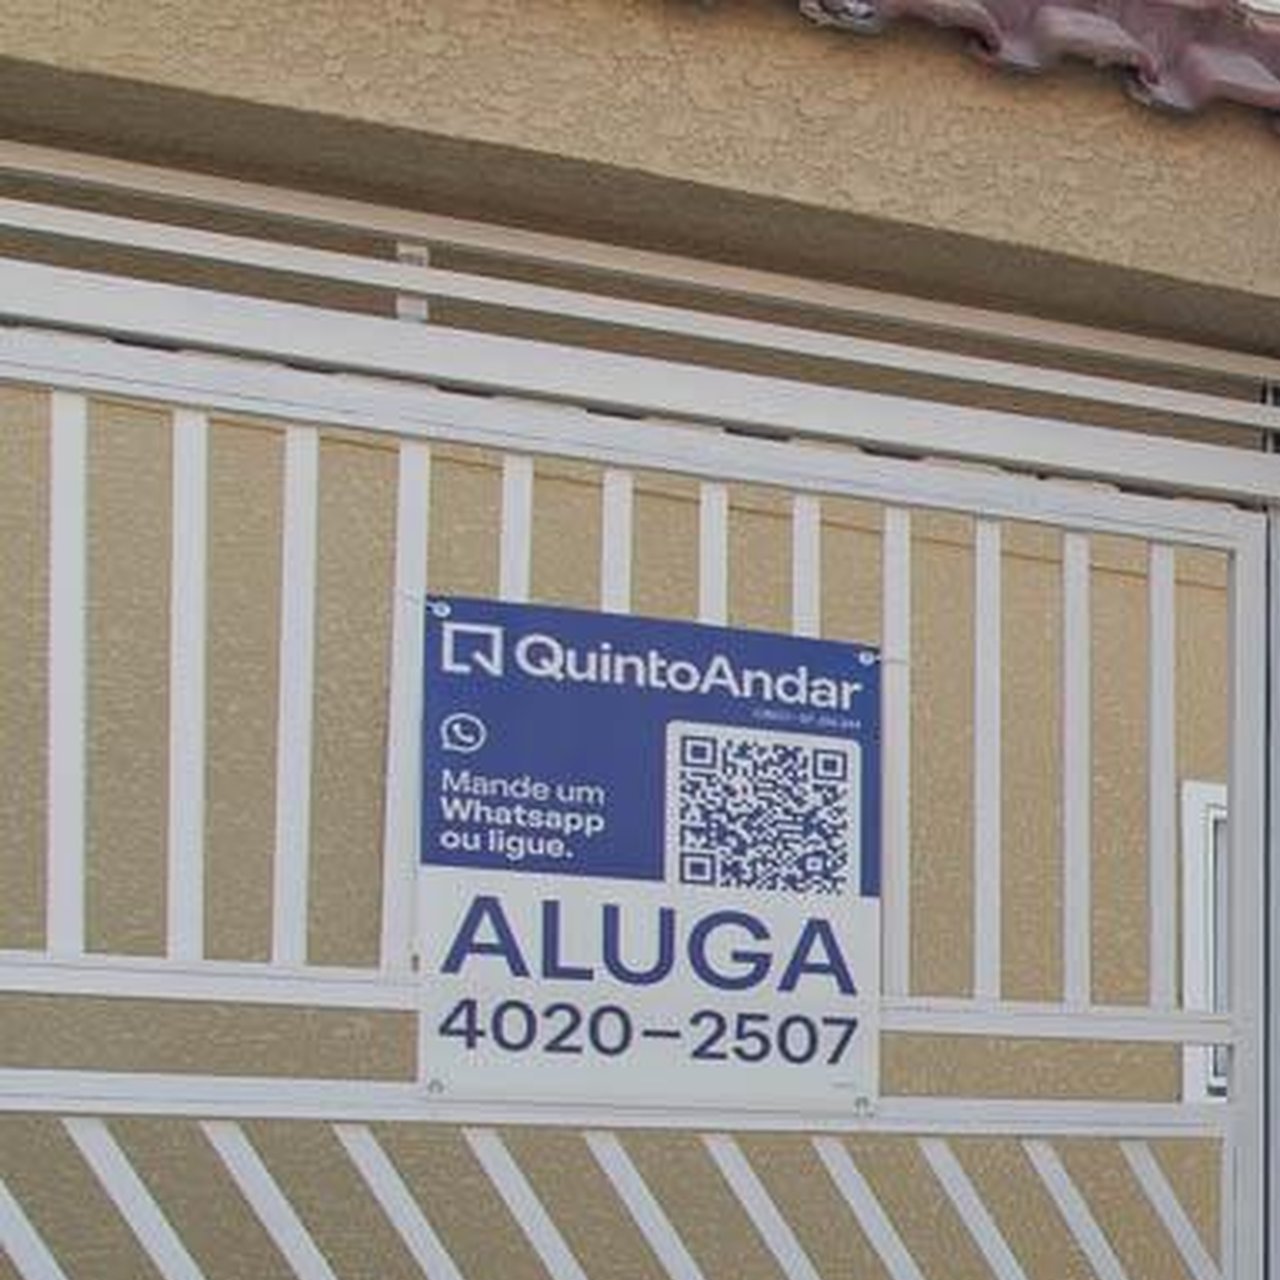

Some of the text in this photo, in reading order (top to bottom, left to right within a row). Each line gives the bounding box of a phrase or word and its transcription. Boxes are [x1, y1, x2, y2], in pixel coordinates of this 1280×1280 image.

[516, 634, 863, 710] QuintoAndar
[442, 769, 604, 805] Mande um
[440, 796, 605, 837] Whatsapp
[440, 829, 574, 861] ou ligue.
[440, 896, 858, 996] ALUGA
[438, 998, 859, 1065] 4020-2507
